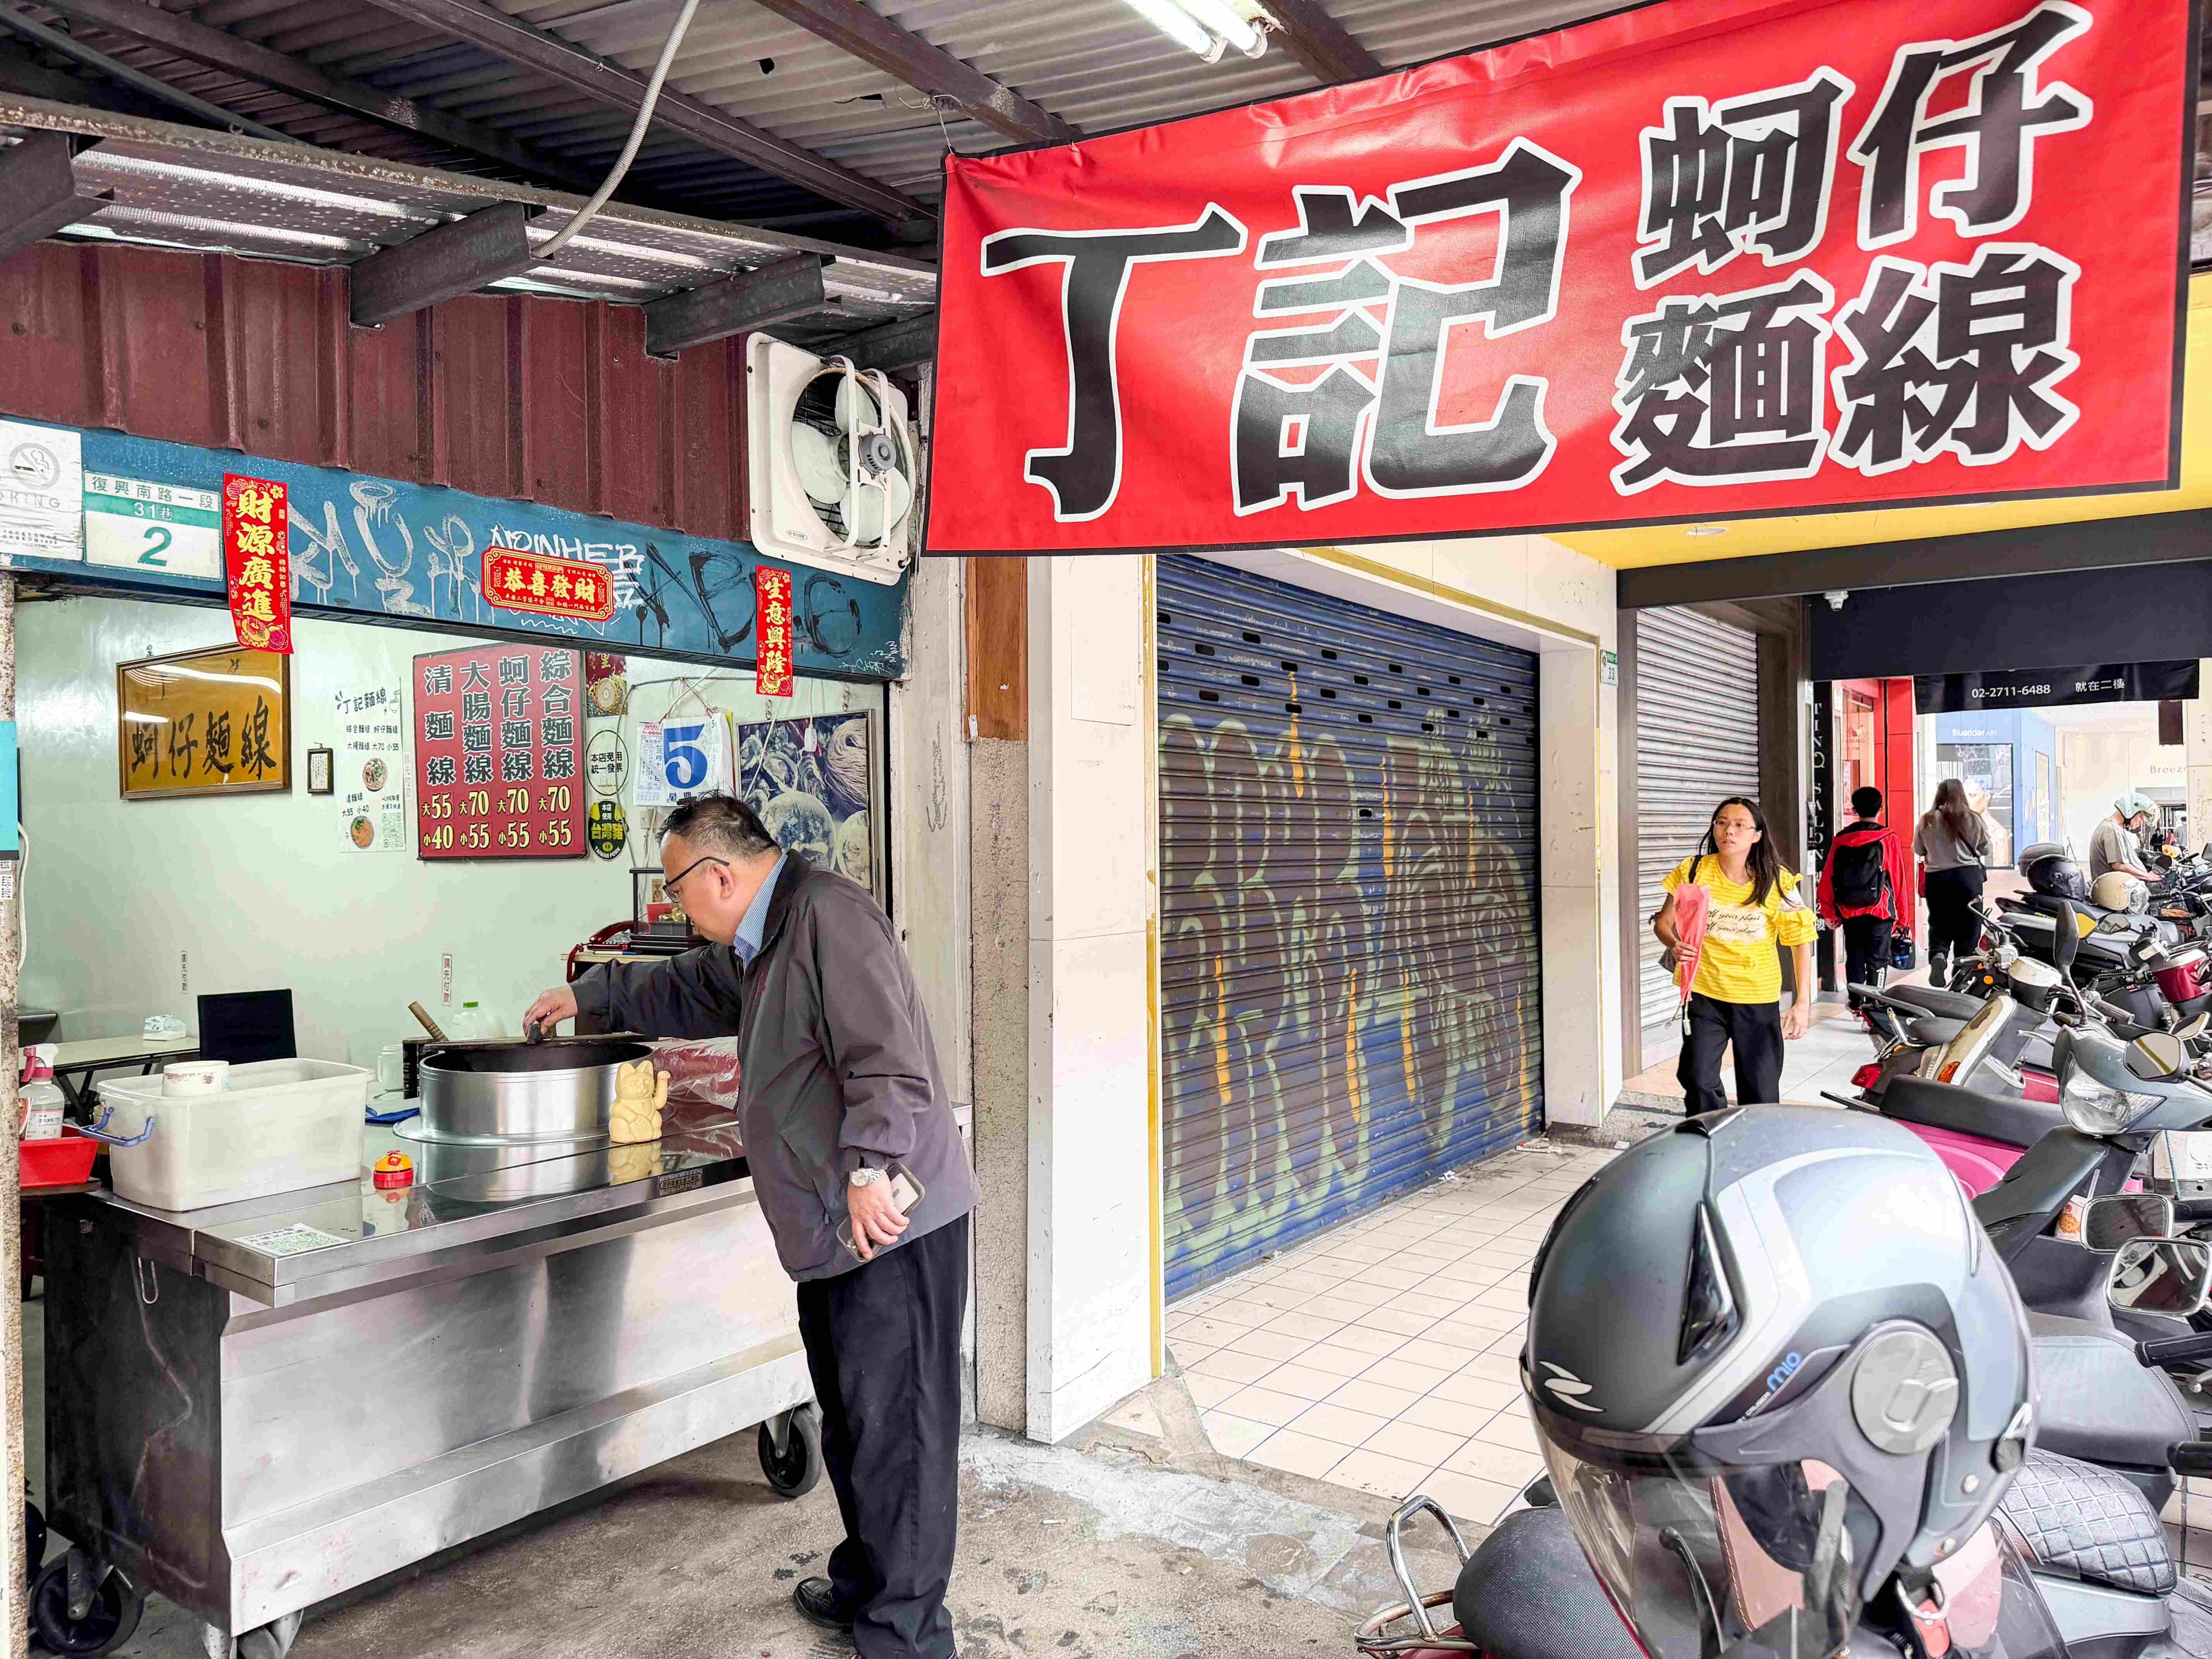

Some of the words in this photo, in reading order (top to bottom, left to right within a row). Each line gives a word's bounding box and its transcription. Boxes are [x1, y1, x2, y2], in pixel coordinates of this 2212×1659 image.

[1631, 1, 2093, 290] 蚵仔
[980, 136, 1582, 522] 丁記
[1609, 243, 2081, 496] 麵線
[92, 476, 213, 509] 復興南路一段
[134, 502, 173, 521] 31巷
[137, 527, 172, 567] 2
[236, 490, 276, 622] 財源廣進
[503, 567, 597, 604] 恭喜發財
[764, 577, 787, 673] 生意興隆
[343, 687, 387, 714] 丁記麵線
[1971, 684, 2051, 699] 02-2711-6488
[2075, 678, 2125, 692] 就在二樓
[424, 665, 456, 786] 清麵線
[460, 661, 494, 784] 大腸麵線
[498, 654, 534, 782] 蚵仔麵線
[540, 650, 575, 779] 綜合麵線
[131, 695, 276, 781] 蚵仔麵線
[663, 724, 708, 789] 5
[422, 793, 453, 820] 大55
[459, 790, 490, 817] 大70
[497, 787, 529, 815] 大70
[537, 785, 571, 813] 大70
[423, 824, 454, 850] 小40
[460, 823, 490, 849] 小55
[498, 821, 530, 849] 小55
[539, 818, 572, 846] 小55
[591, 823, 623, 840] 台灣豬
[594, 846, 609, 859] TAIWAN
[609, 846, 621, 858] PORK
[1767, 1352, 1802, 1391] mio
